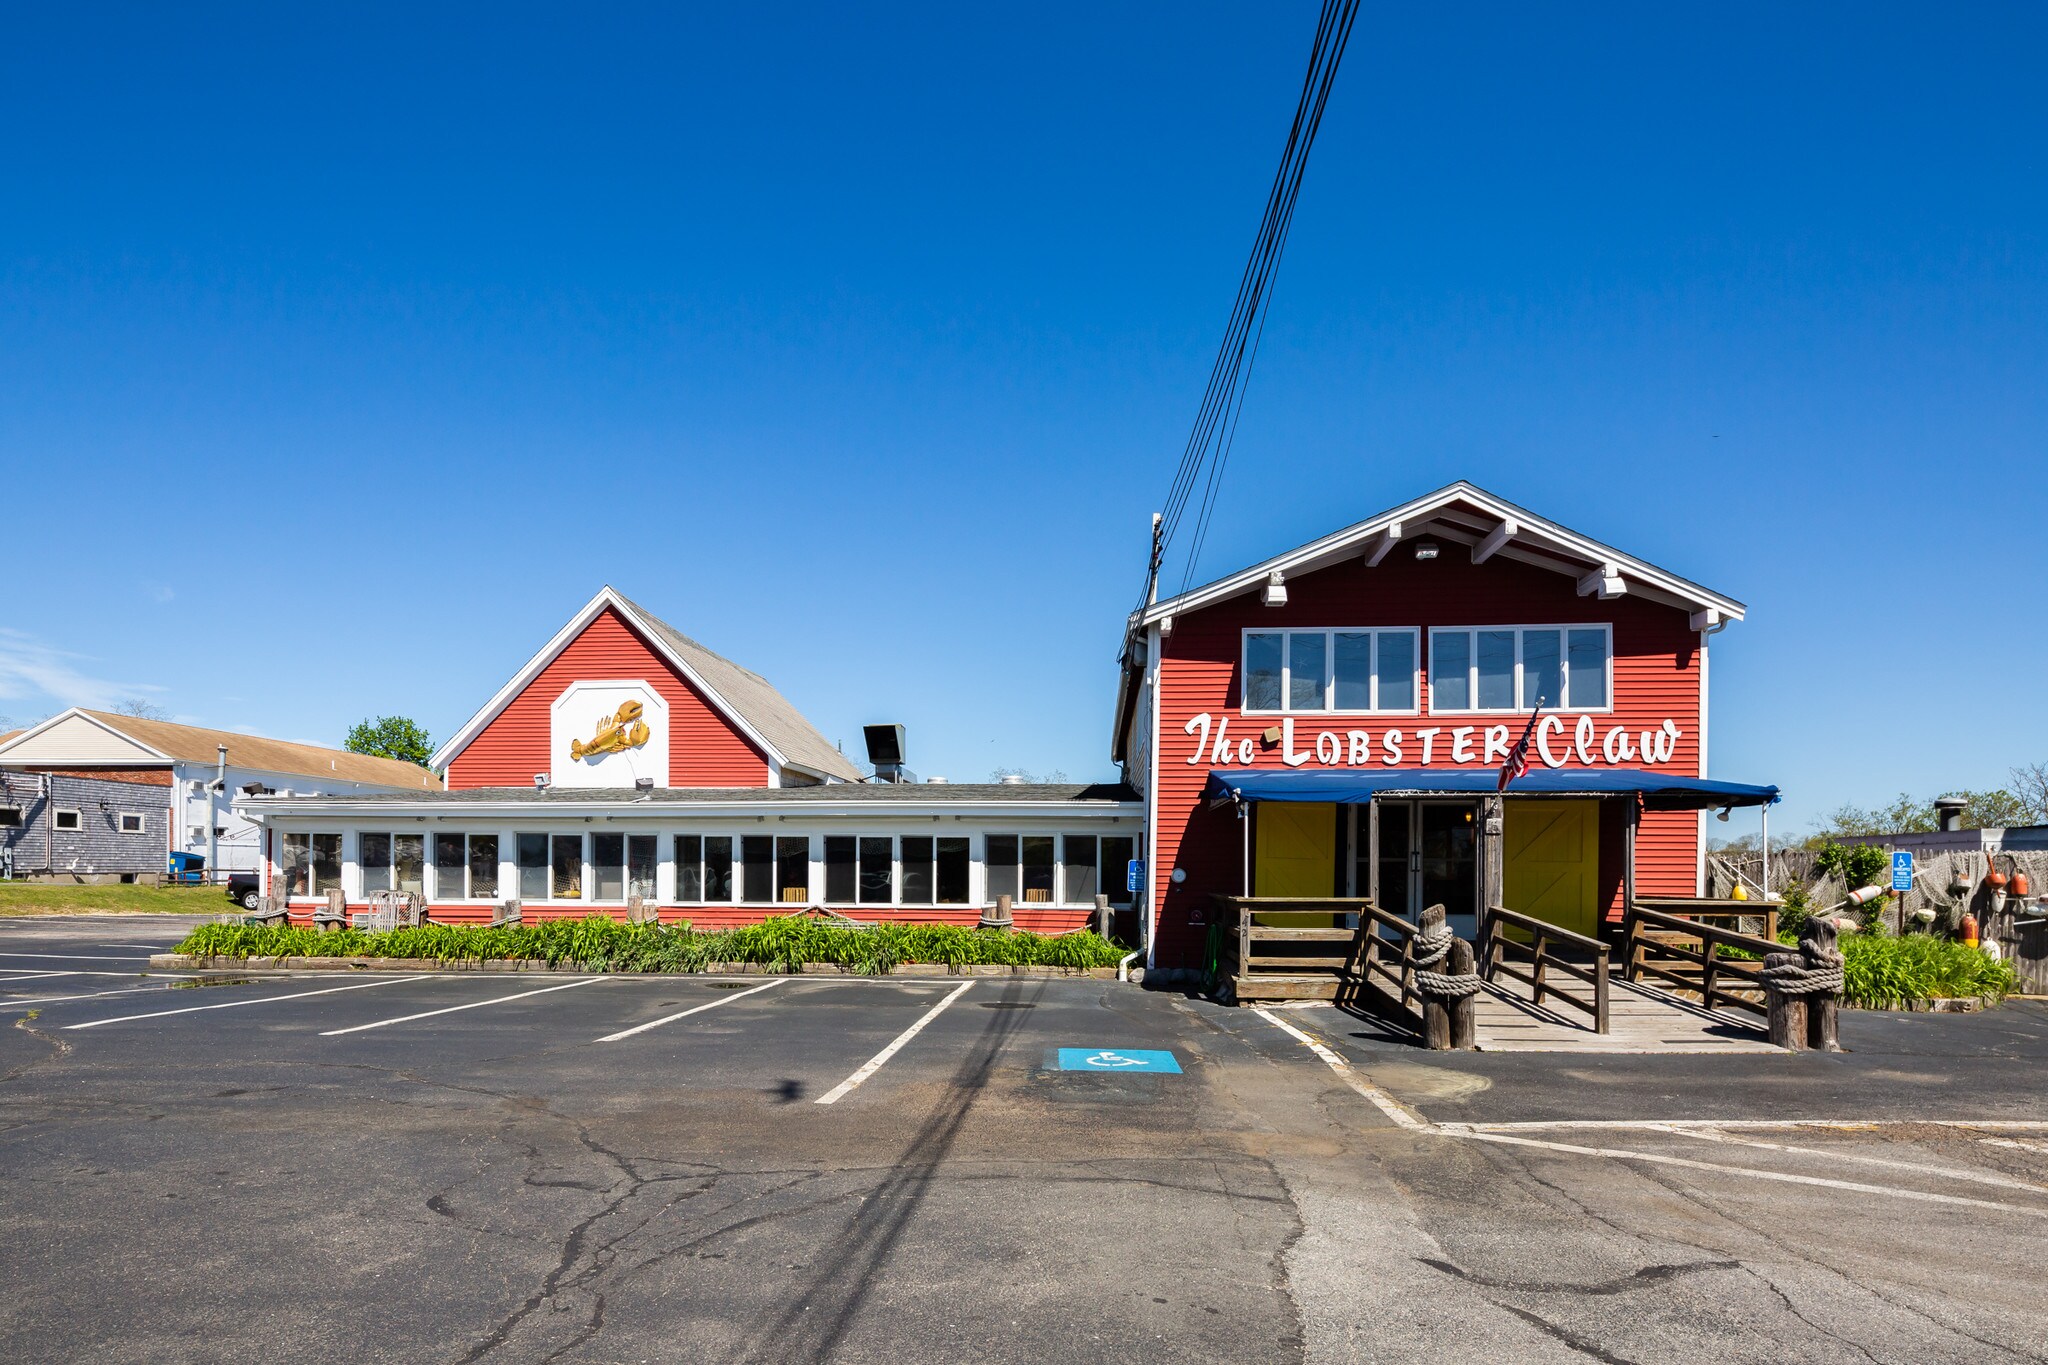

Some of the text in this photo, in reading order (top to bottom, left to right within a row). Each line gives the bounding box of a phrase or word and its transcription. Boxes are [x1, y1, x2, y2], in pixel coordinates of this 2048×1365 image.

[1184, 711, 1683, 769] The LOBSTER Claw
